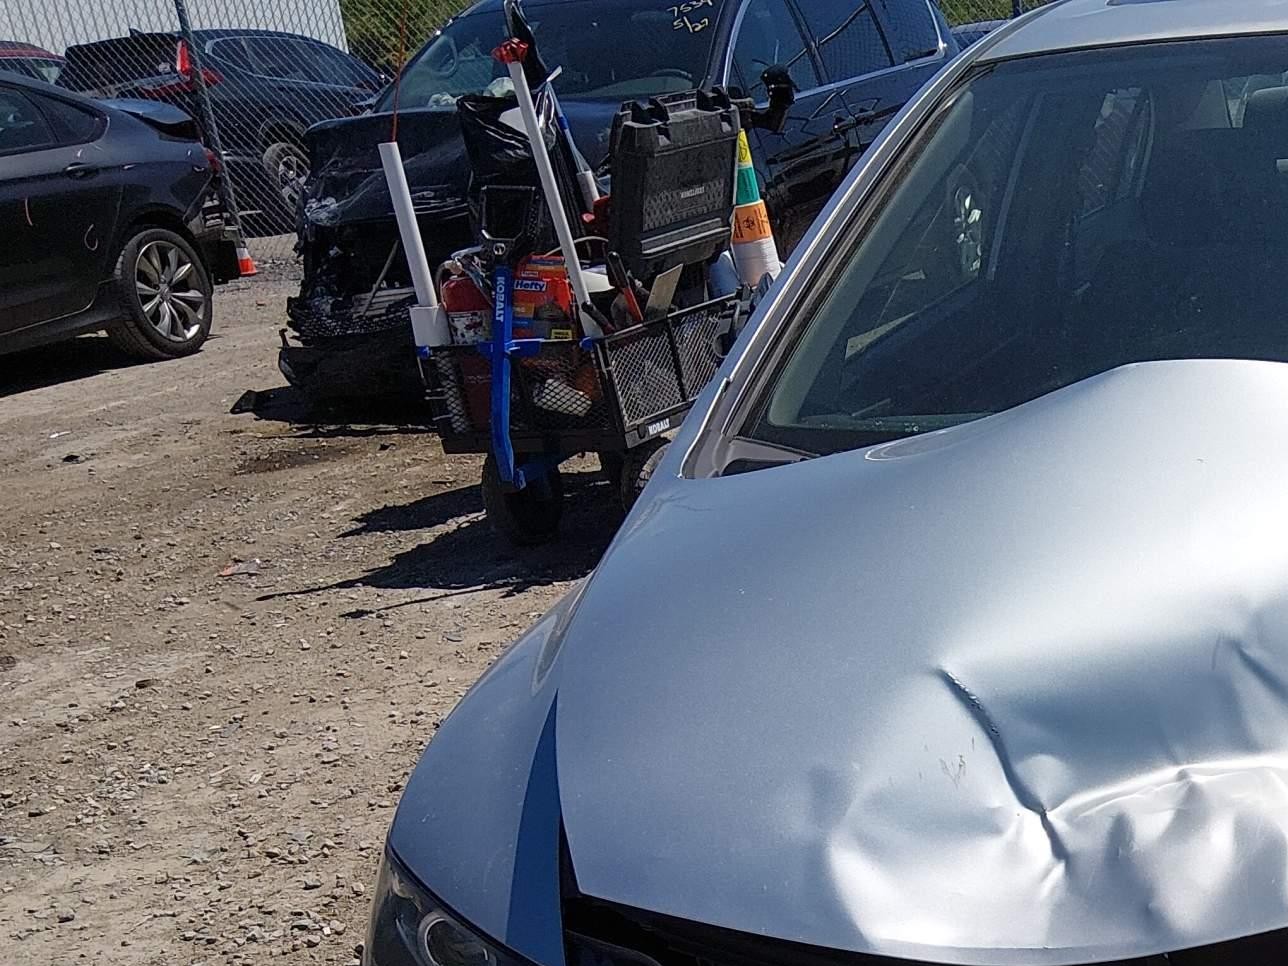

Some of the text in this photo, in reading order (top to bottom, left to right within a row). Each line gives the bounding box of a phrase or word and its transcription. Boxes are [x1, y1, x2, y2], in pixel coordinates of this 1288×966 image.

[515, 280, 546, 291] Hefty
[494, 276, 505, 323] KOBALT
[648, 418, 671, 436] KOBALT
